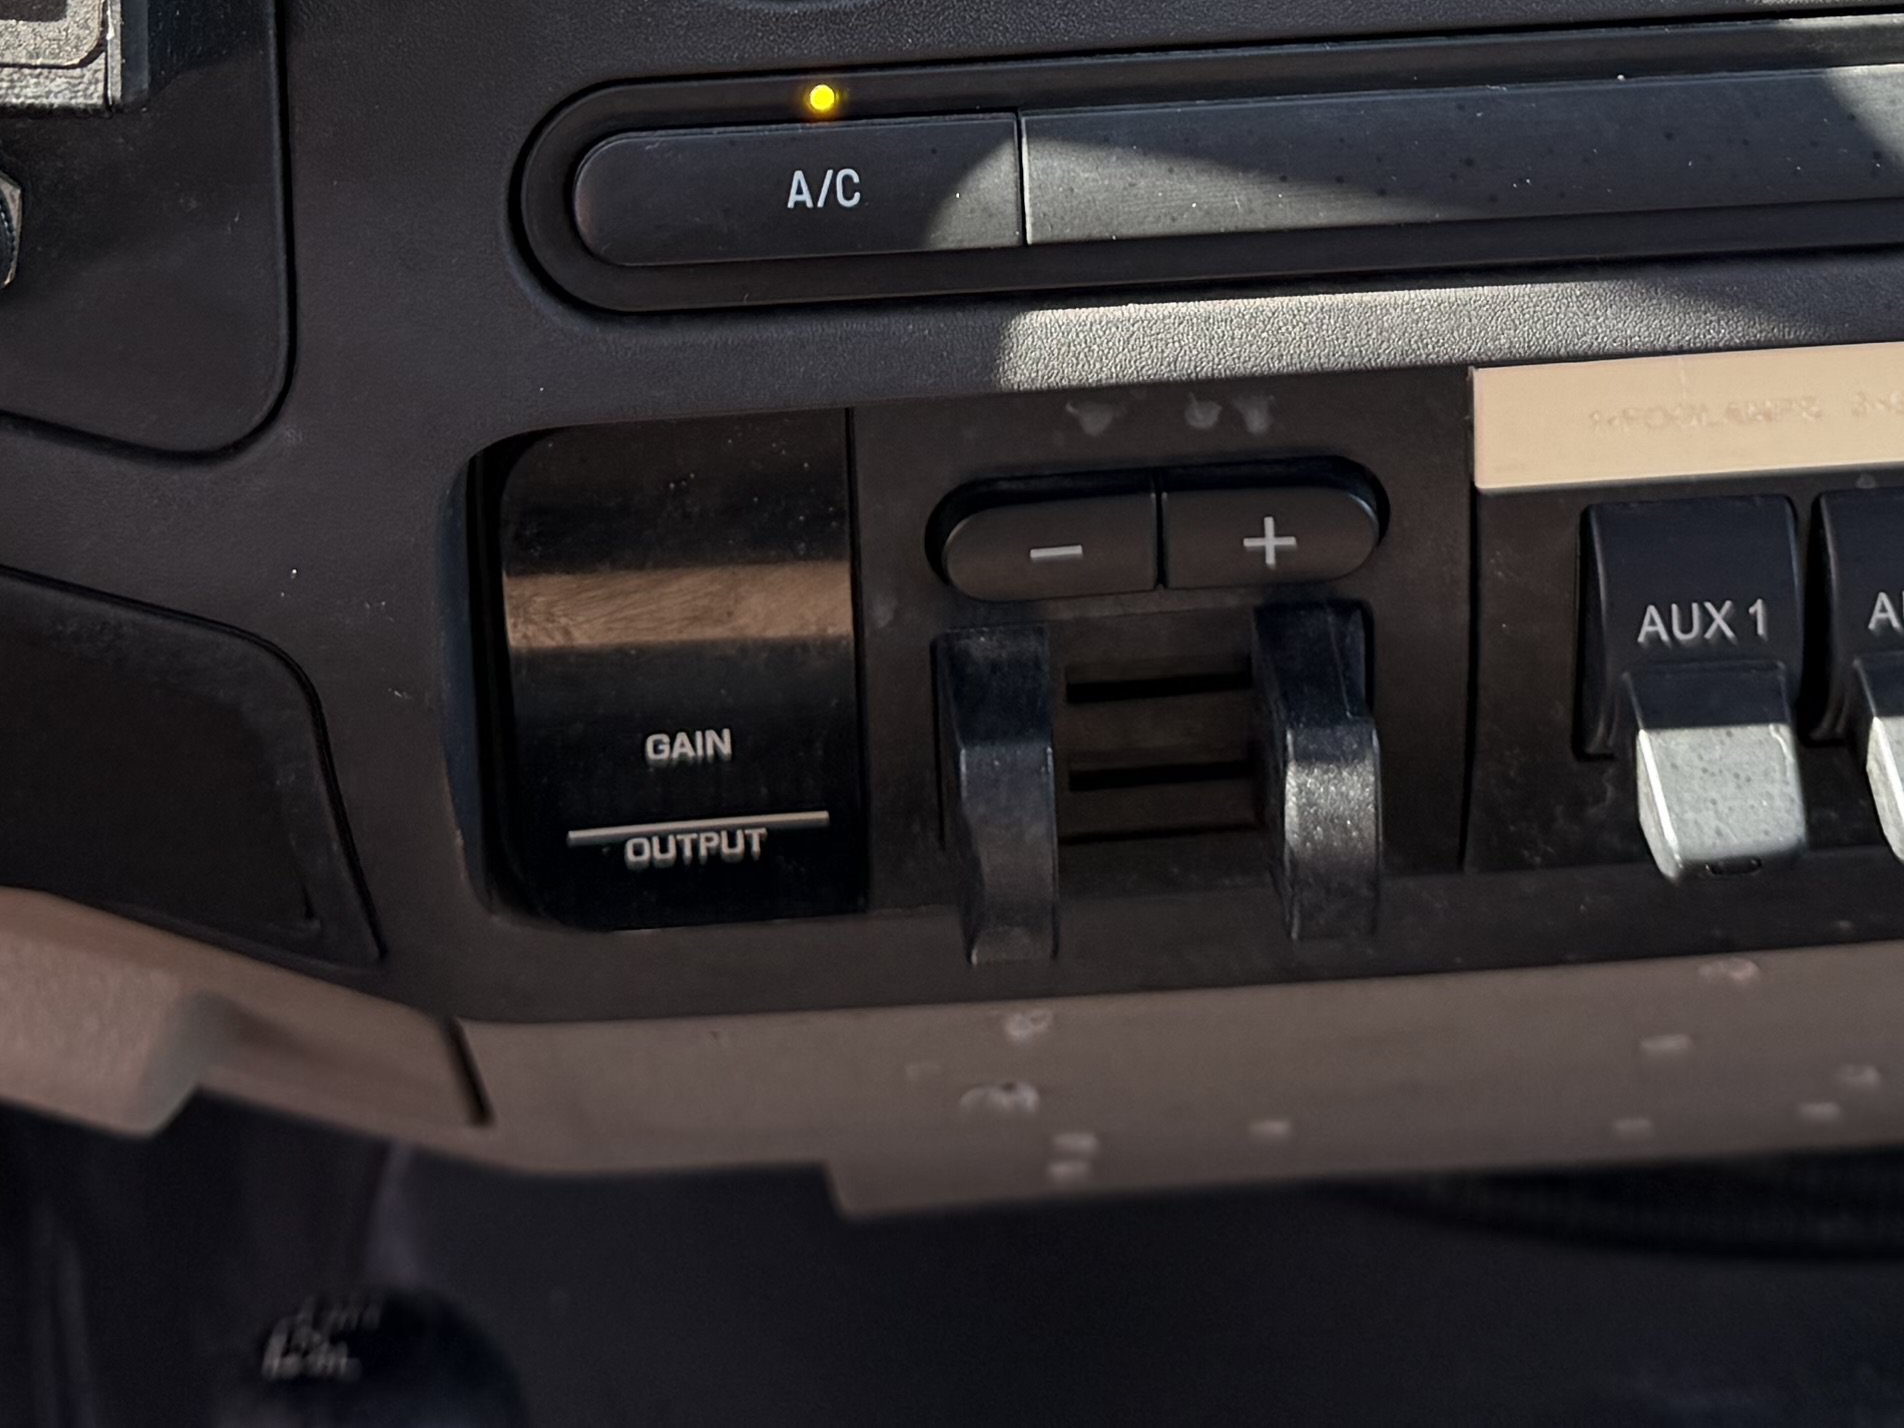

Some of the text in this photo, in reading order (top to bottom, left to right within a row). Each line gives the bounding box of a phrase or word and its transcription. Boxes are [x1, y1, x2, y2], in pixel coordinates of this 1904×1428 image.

[788, 169, 860, 208] A/C
[1638, 599, 1765, 643] AUX 1
[646, 729, 731, 761] GAIN
[624, 826, 768, 866] OUTPUT
